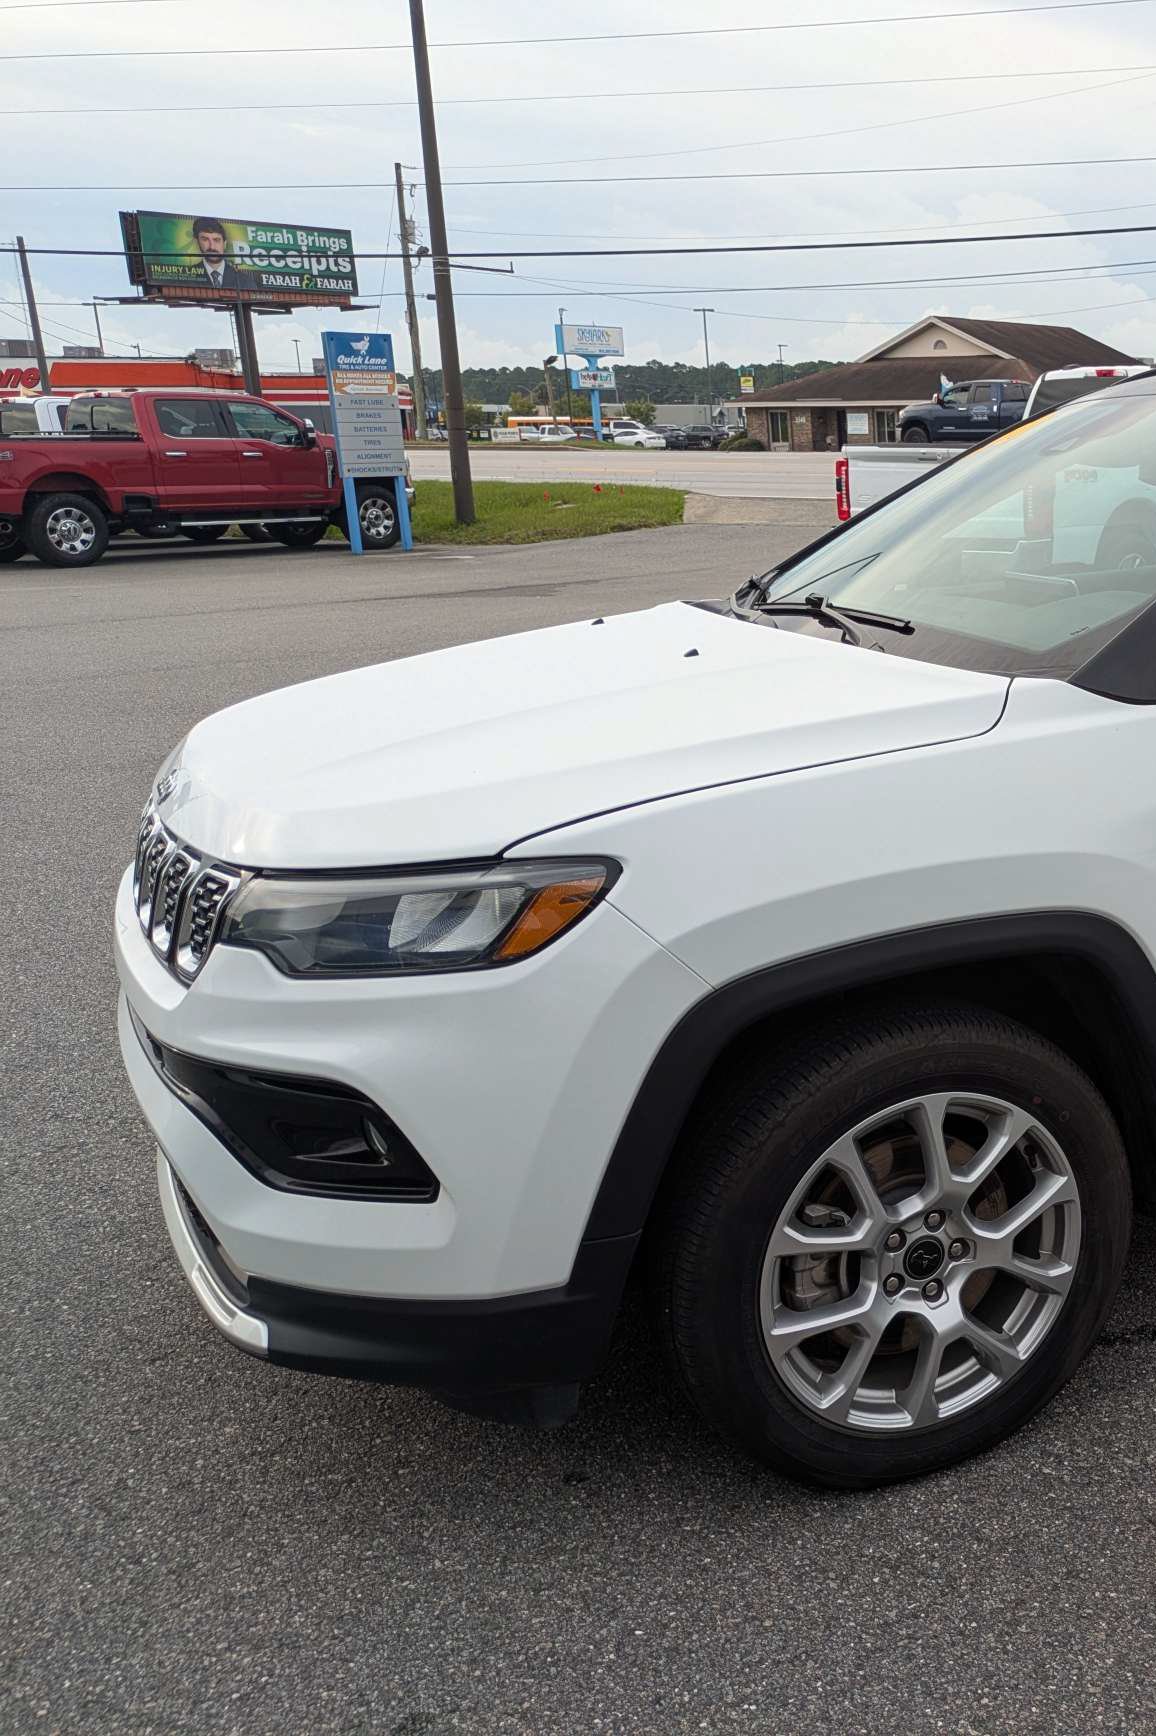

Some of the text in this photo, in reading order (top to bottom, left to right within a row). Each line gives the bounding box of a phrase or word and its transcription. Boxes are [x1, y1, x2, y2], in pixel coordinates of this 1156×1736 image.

[247, 226, 348, 251] Farah Brings
[233, 240, 352, 275] Receipts
[150, 264, 206, 276] INJURY LAW
[261, 273, 301, 287] FARAH
[317, 277, 353, 290] FARAH
[337, 354, 388, 365] Quick Lane
[0, 367, 41, 389] ne
